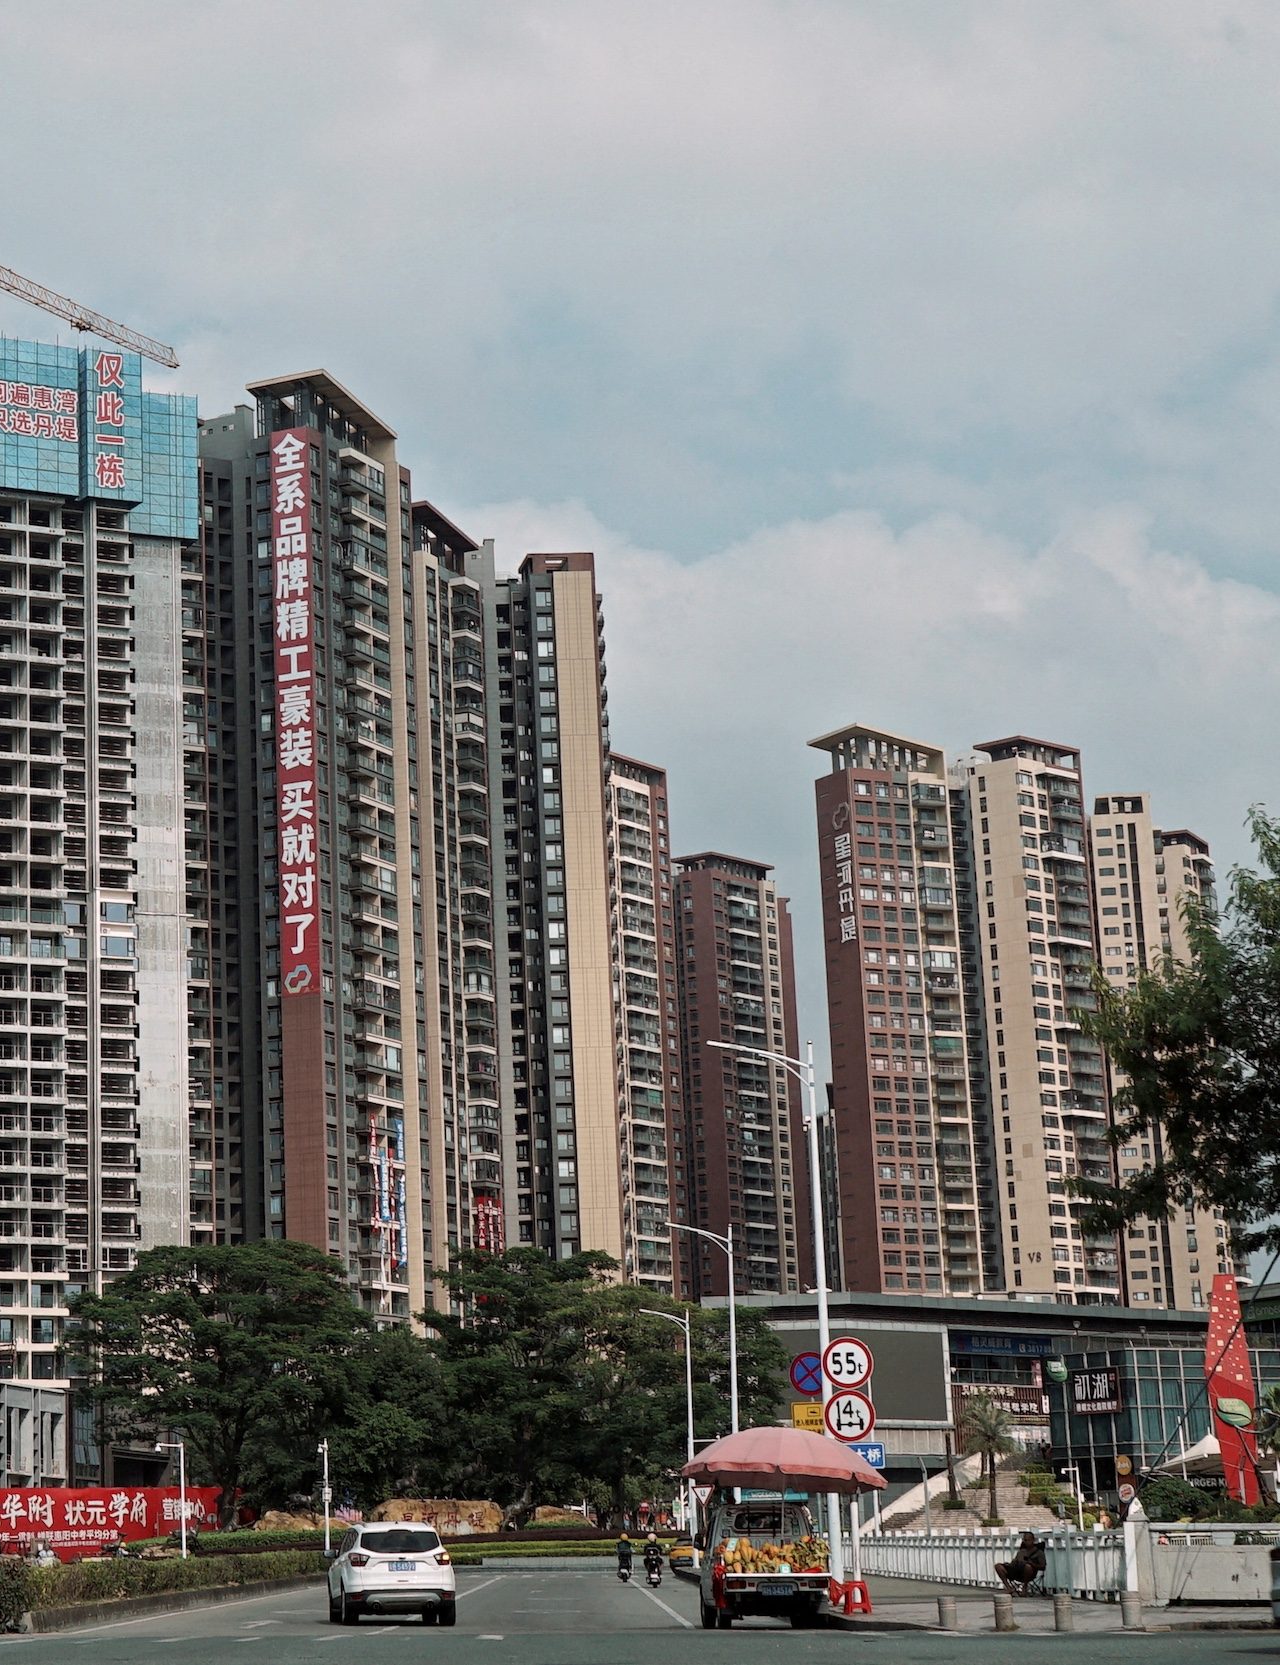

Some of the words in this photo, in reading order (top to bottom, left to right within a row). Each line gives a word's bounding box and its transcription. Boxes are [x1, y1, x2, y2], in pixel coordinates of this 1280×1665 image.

[95, 352, 125, 488] 仅此一栋
[273, 433, 313, 770] 全系品牌精工豪装
[281, 779, 316, 955] 买就对了
[64, 1491, 148, 1528] 状元学府
